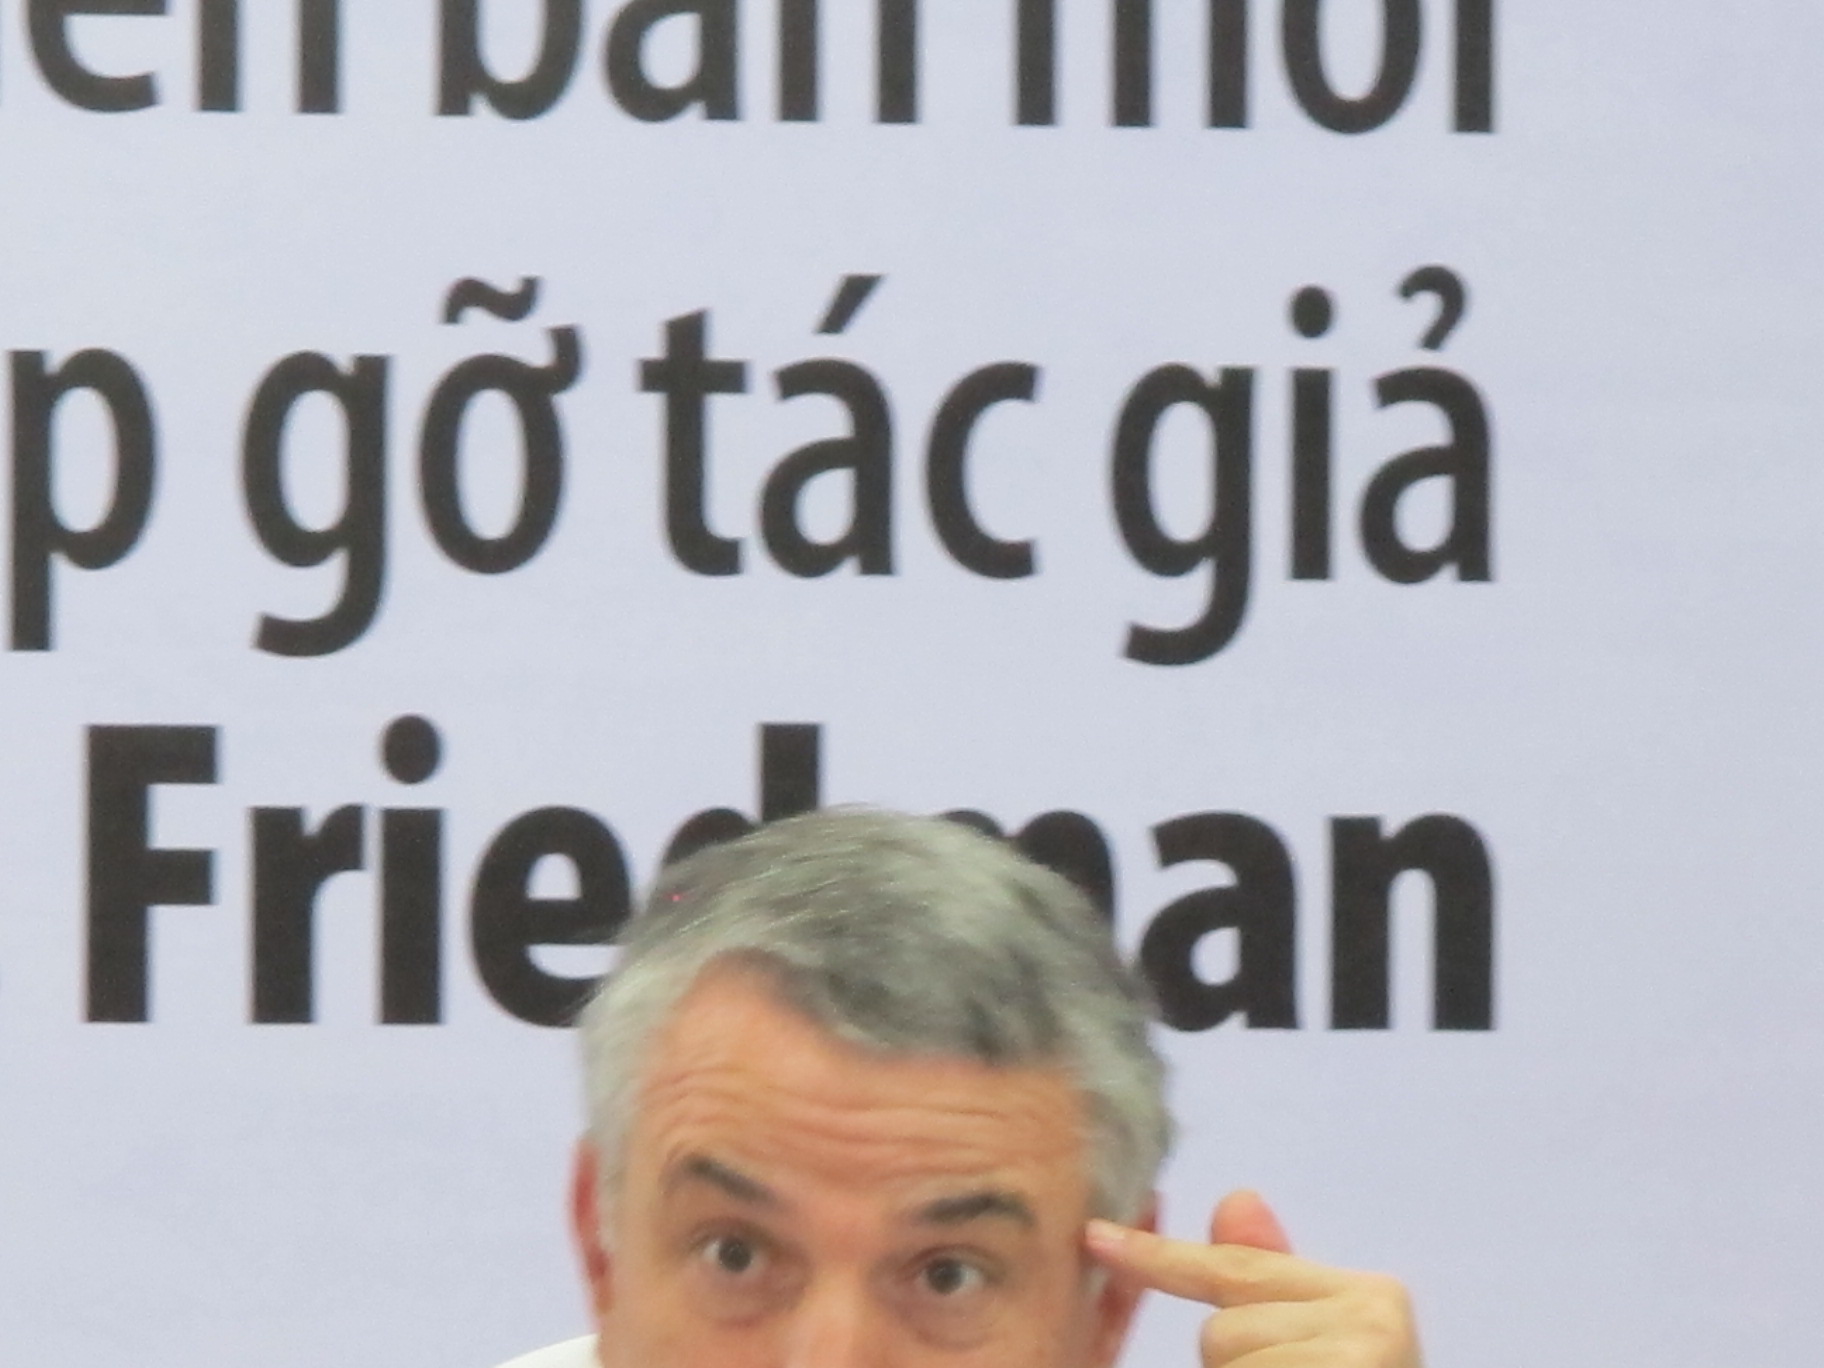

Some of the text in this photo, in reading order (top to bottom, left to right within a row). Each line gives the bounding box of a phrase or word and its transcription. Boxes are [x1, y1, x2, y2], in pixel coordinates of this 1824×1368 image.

[240, 276, 584, 659] gỡ
[637, 273, 1041, 580] tác
[1108, 264, 1494, 668] giả
[82, 713, 1497, 1033] Friean
